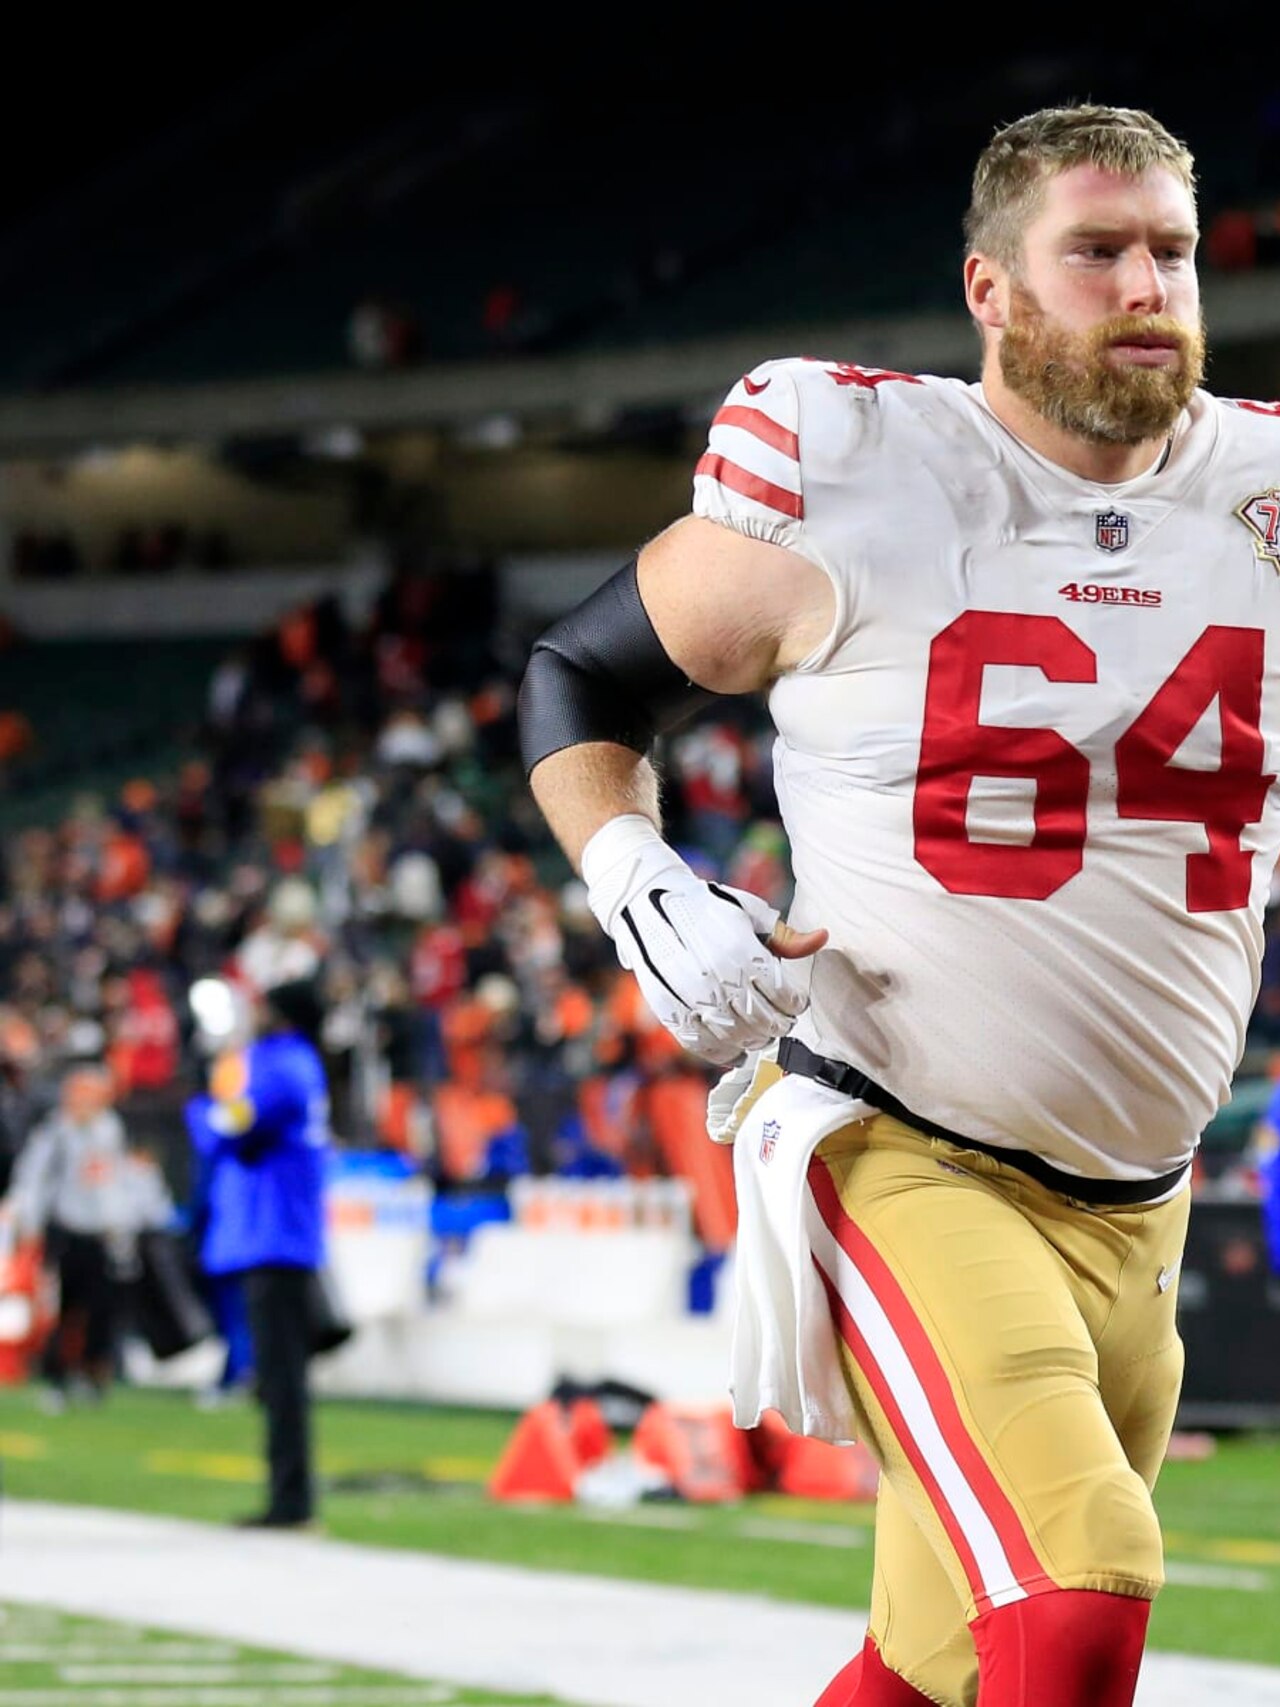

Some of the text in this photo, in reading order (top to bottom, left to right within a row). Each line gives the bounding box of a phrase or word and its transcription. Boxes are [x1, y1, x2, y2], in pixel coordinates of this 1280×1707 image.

[1100, 528, 1125, 547] NFL
[1058, 583, 1162, 604] 49ERS
[913, 608, 1277, 914] 64
